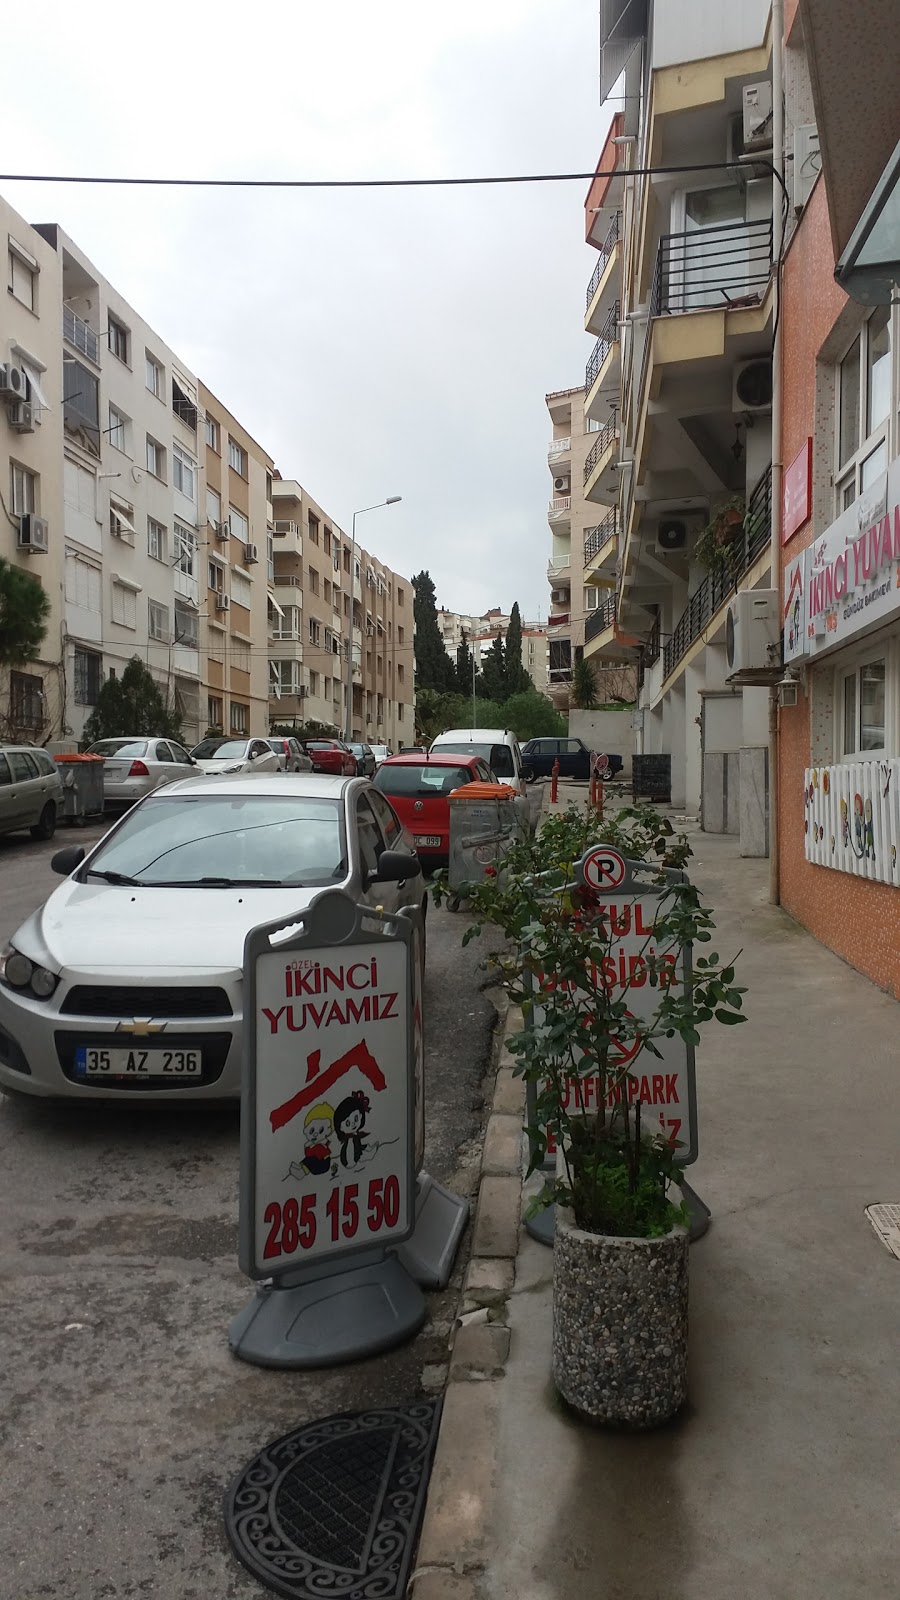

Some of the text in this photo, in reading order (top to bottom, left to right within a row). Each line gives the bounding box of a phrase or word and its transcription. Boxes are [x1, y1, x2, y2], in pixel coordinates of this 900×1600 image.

[809, 536, 848, 619] İKİNCİ
[426, 837, 439, 846] 099
[285, 957, 378, 998] İKİNCİ
[291, 959, 316, 970] ÖZEL
[261, 992, 400, 1035] YUVAMIZ
[88, 1051, 111, 1072] 35
[126, 1052, 149, 1072] AZ
[162, 1053, 198, 1073] 236
[546, 1071, 680, 1109] ÜTFN PARK
[263, 1174, 400, 1260] 285 15 50
